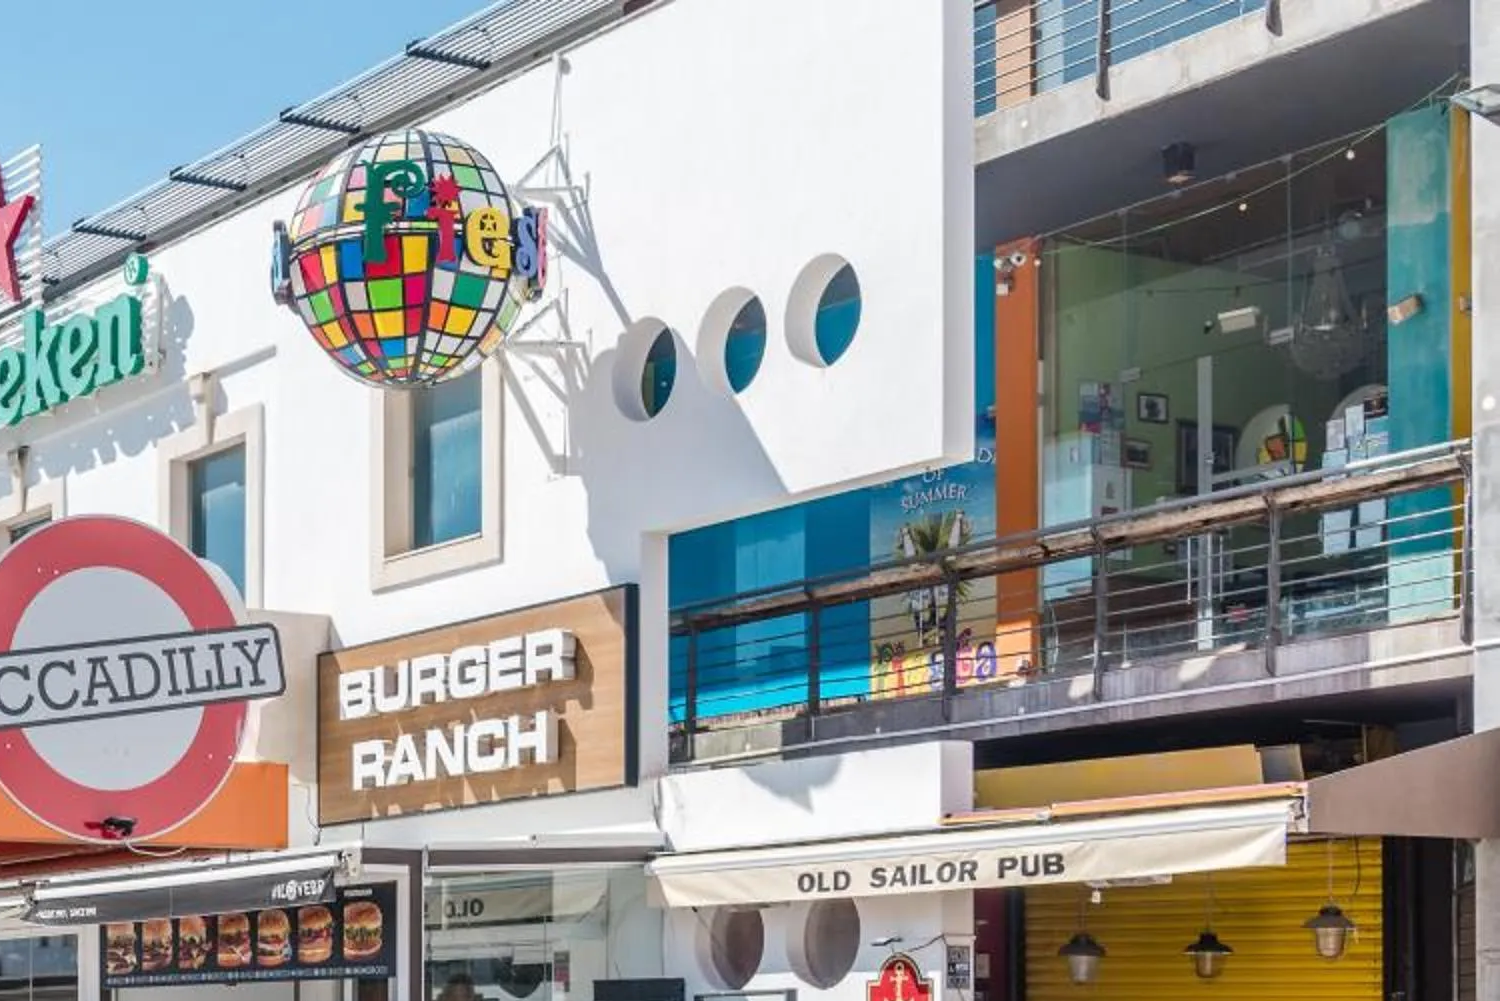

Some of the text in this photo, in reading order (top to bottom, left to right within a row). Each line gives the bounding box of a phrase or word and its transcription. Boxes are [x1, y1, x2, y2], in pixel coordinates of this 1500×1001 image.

[901, 483, 966, 512] SUMMER
[340, 628, 576, 720] BURGER
[352, 710, 558, 790] RANCH
[798, 853, 1065, 893] OLD SAILOR PUB
